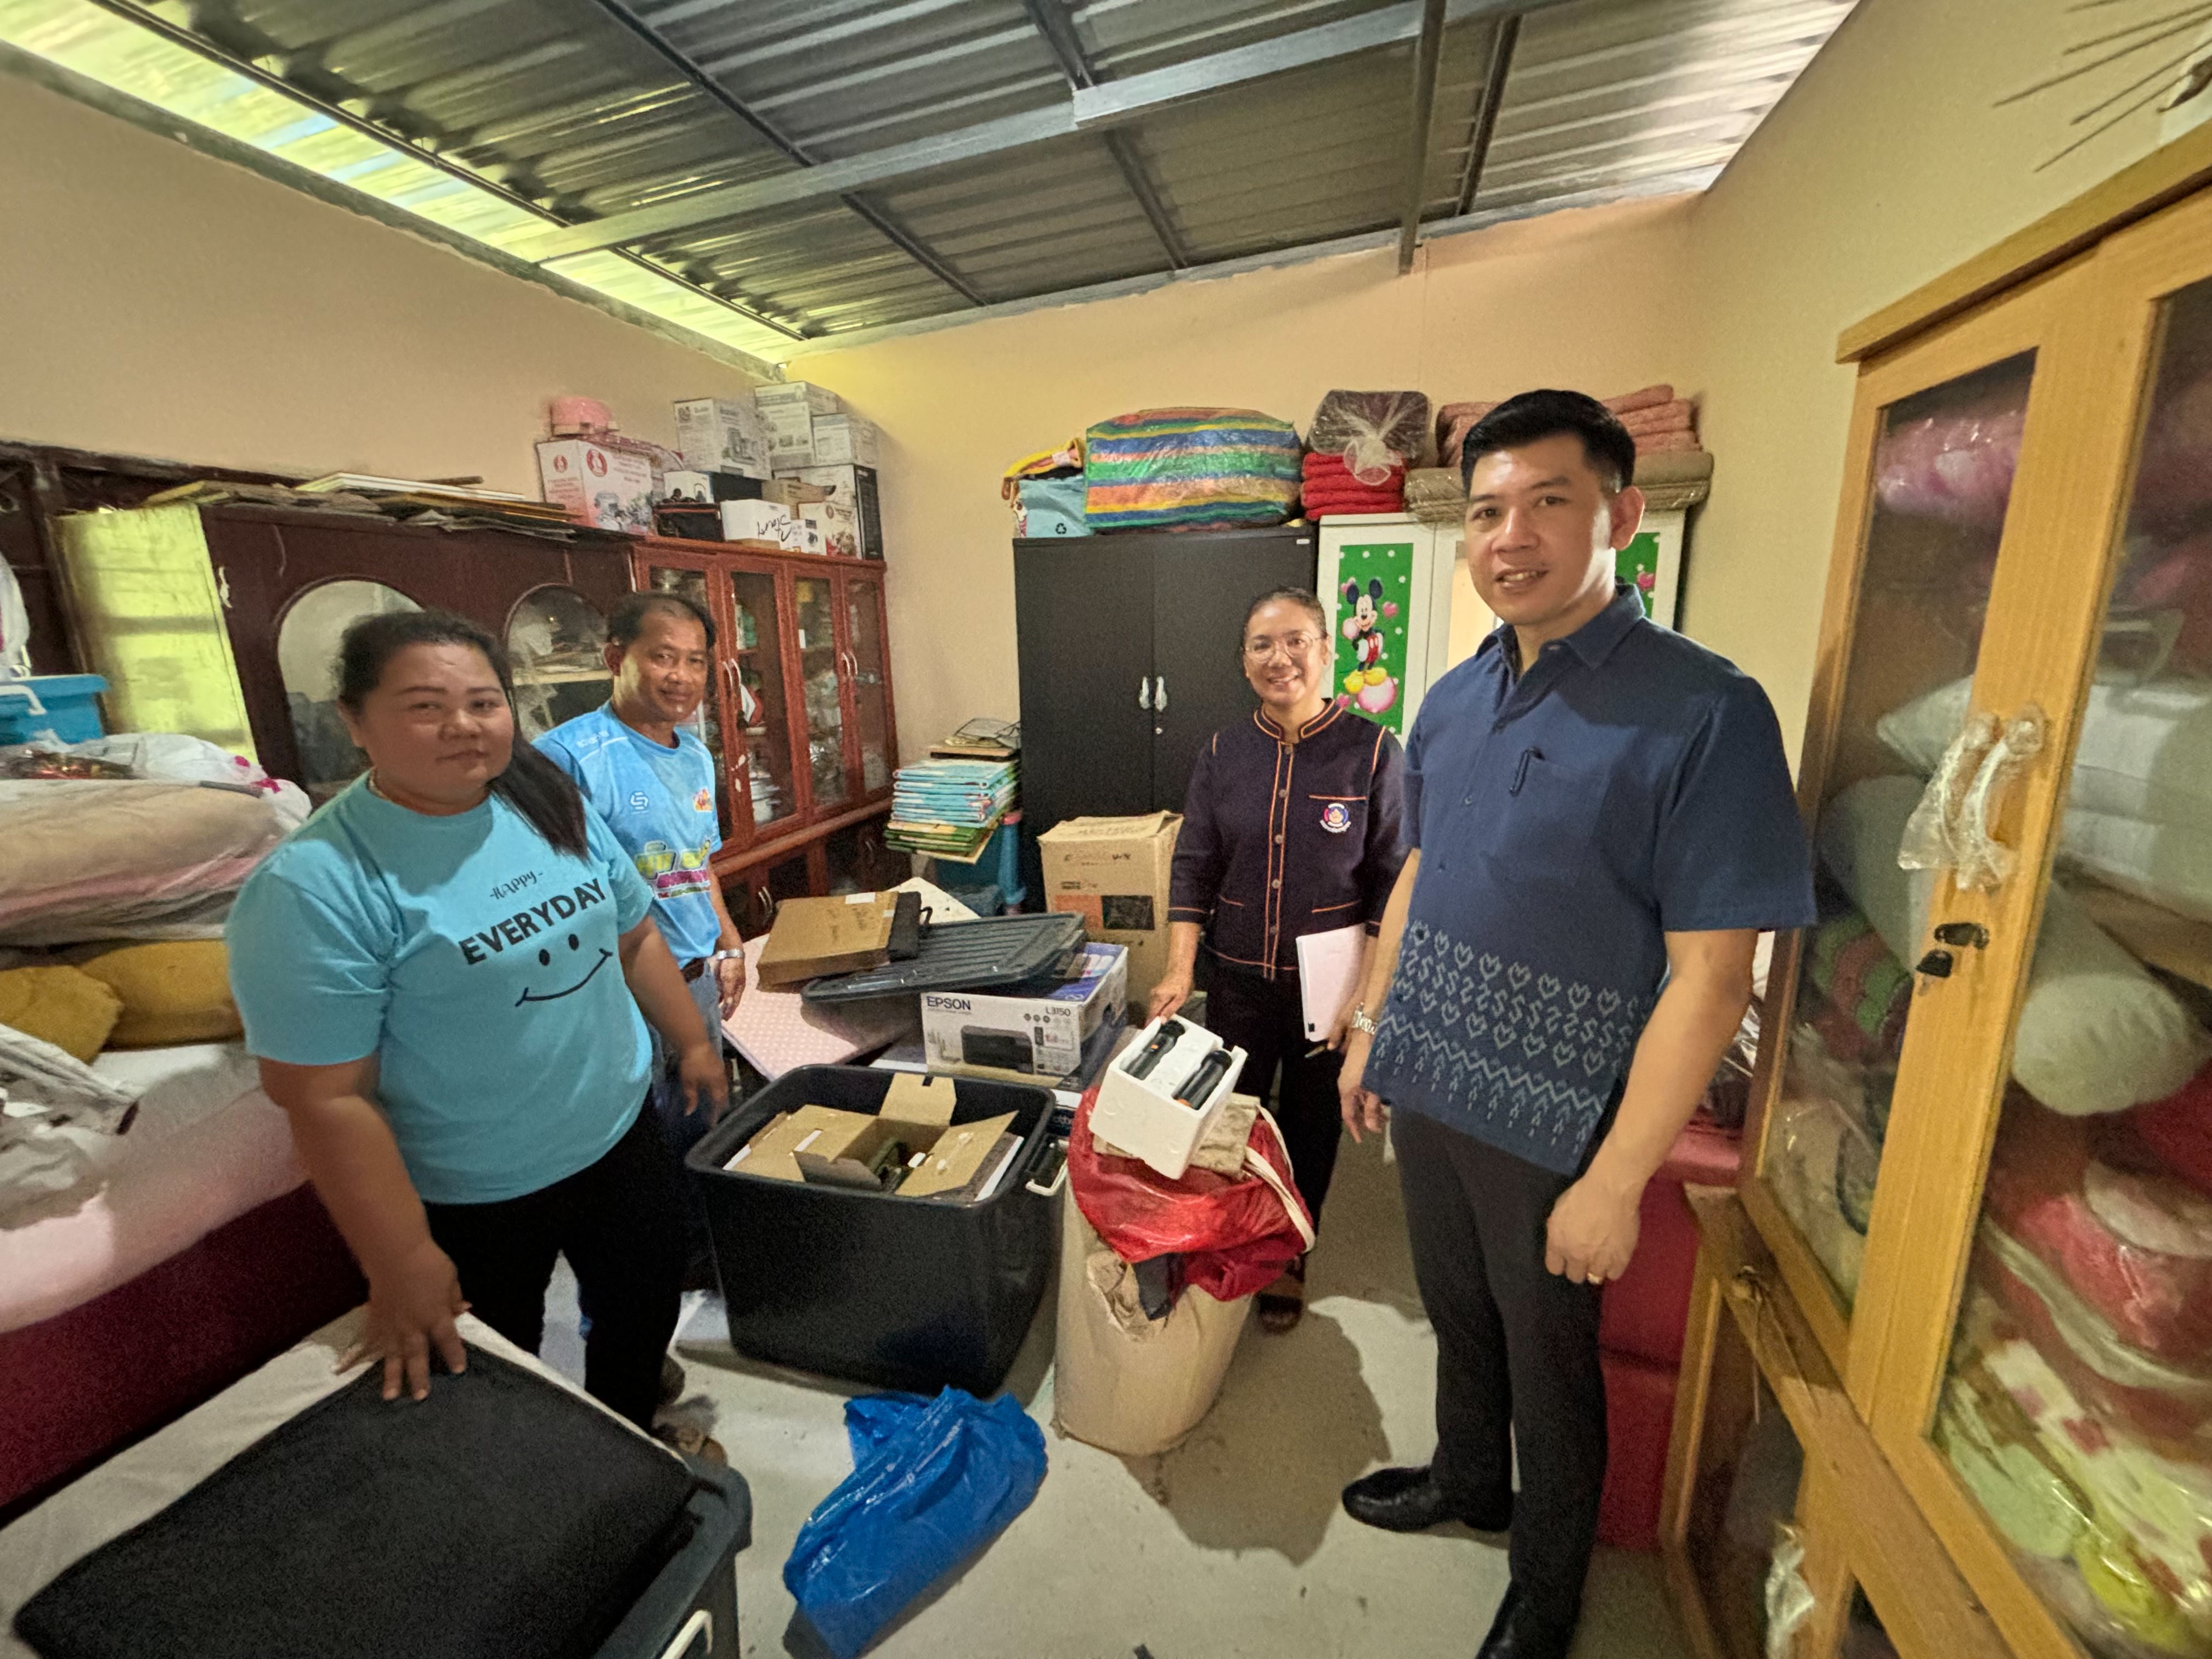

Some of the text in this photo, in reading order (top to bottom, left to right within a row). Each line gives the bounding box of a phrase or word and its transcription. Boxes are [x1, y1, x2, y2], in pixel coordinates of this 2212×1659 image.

[458, 878, 606, 966] EVERYDAY
[926, 996, 971, 1010] EPSON
[1045, 1006, 1071, 1017] L3150
